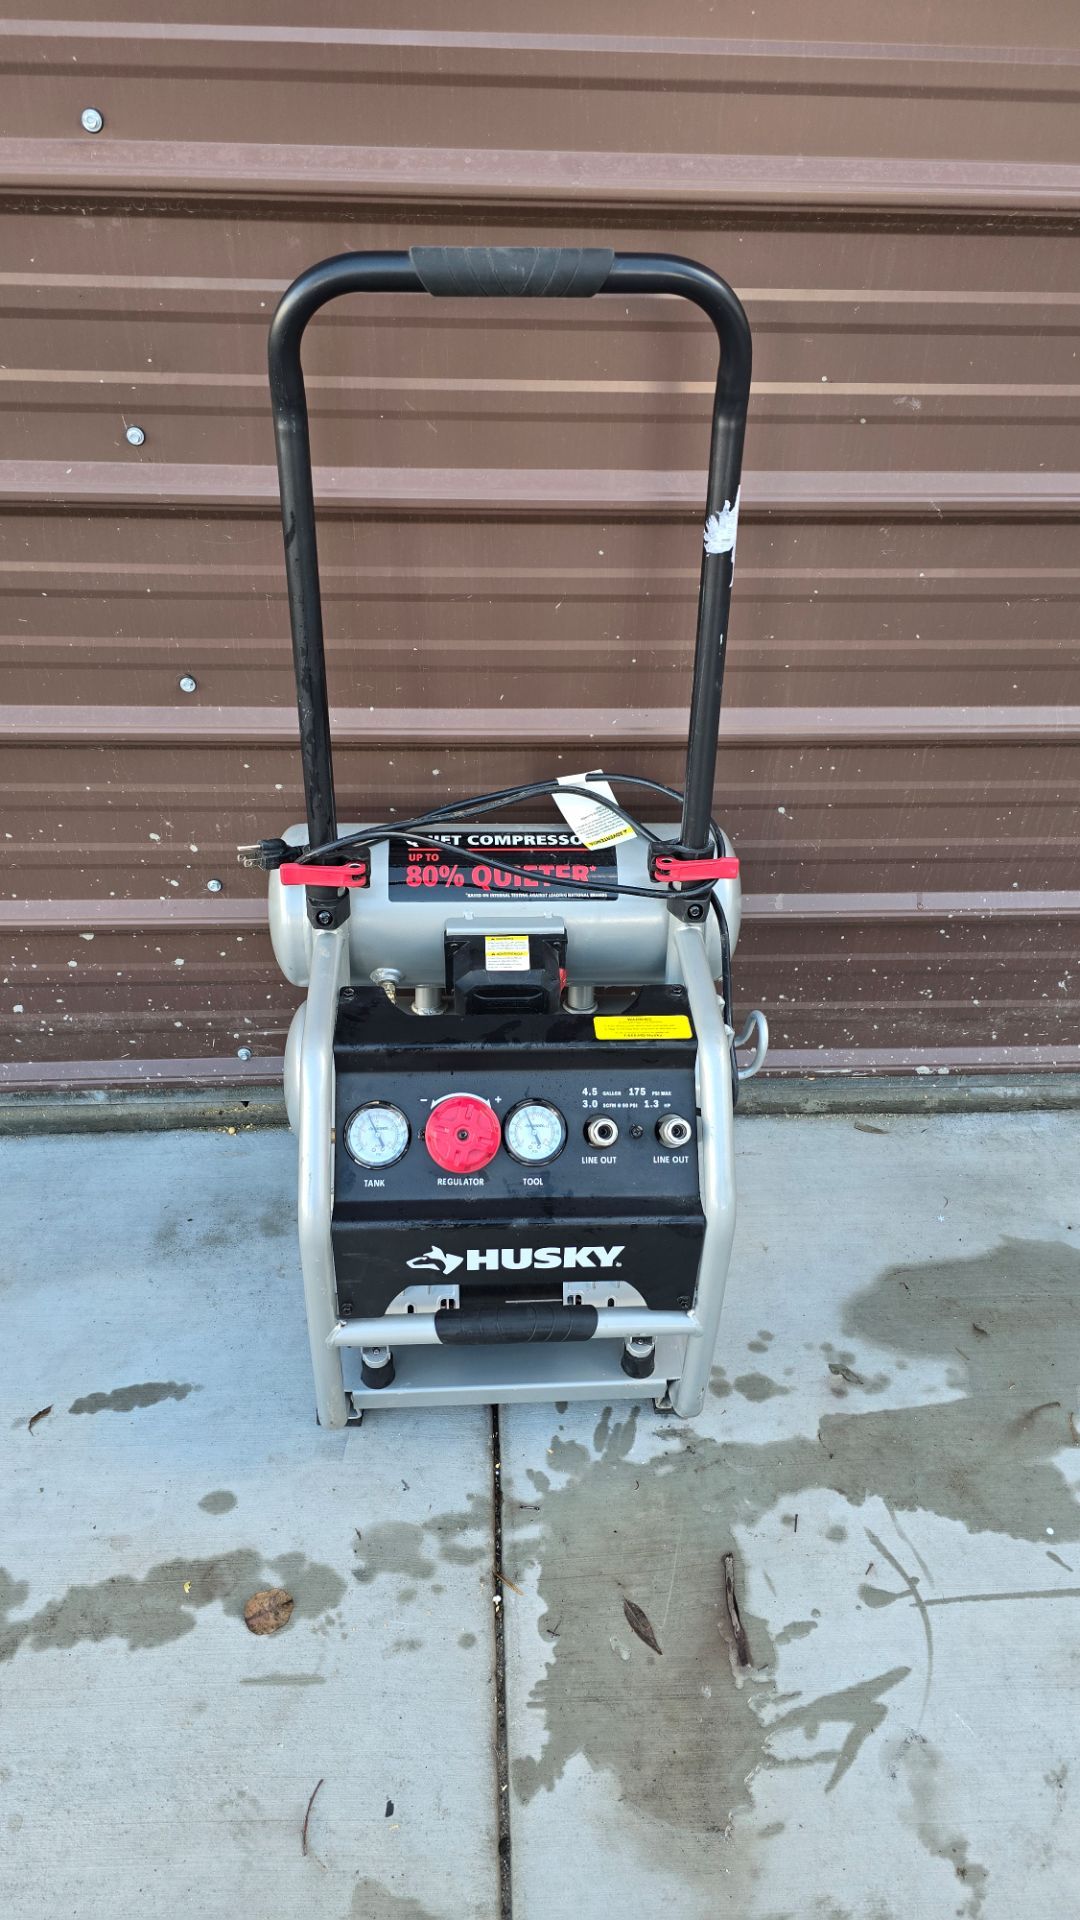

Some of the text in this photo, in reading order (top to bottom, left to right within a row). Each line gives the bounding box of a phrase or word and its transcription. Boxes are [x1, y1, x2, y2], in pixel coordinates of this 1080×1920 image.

[467, 835, 583, 846] COMPRESSO
[408, 853, 440, 862] UP TO
[406, 864, 465, 888] 80%
[582, 1087, 598, 1096] 4.5
[628, 1087, 646, 1096] 175
[582, 1100, 598, 1108] 3.0
[644, 1100, 659, 1108] 1.3
[653, 1156, 689, 1164] LINE OUT
[364, 1179, 385, 1187] TANK
[437, 1178, 485, 1186] REGULATOR
[523, 1178, 544, 1186] TOOL
[466, 1245, 626, 1271] HUSKY
